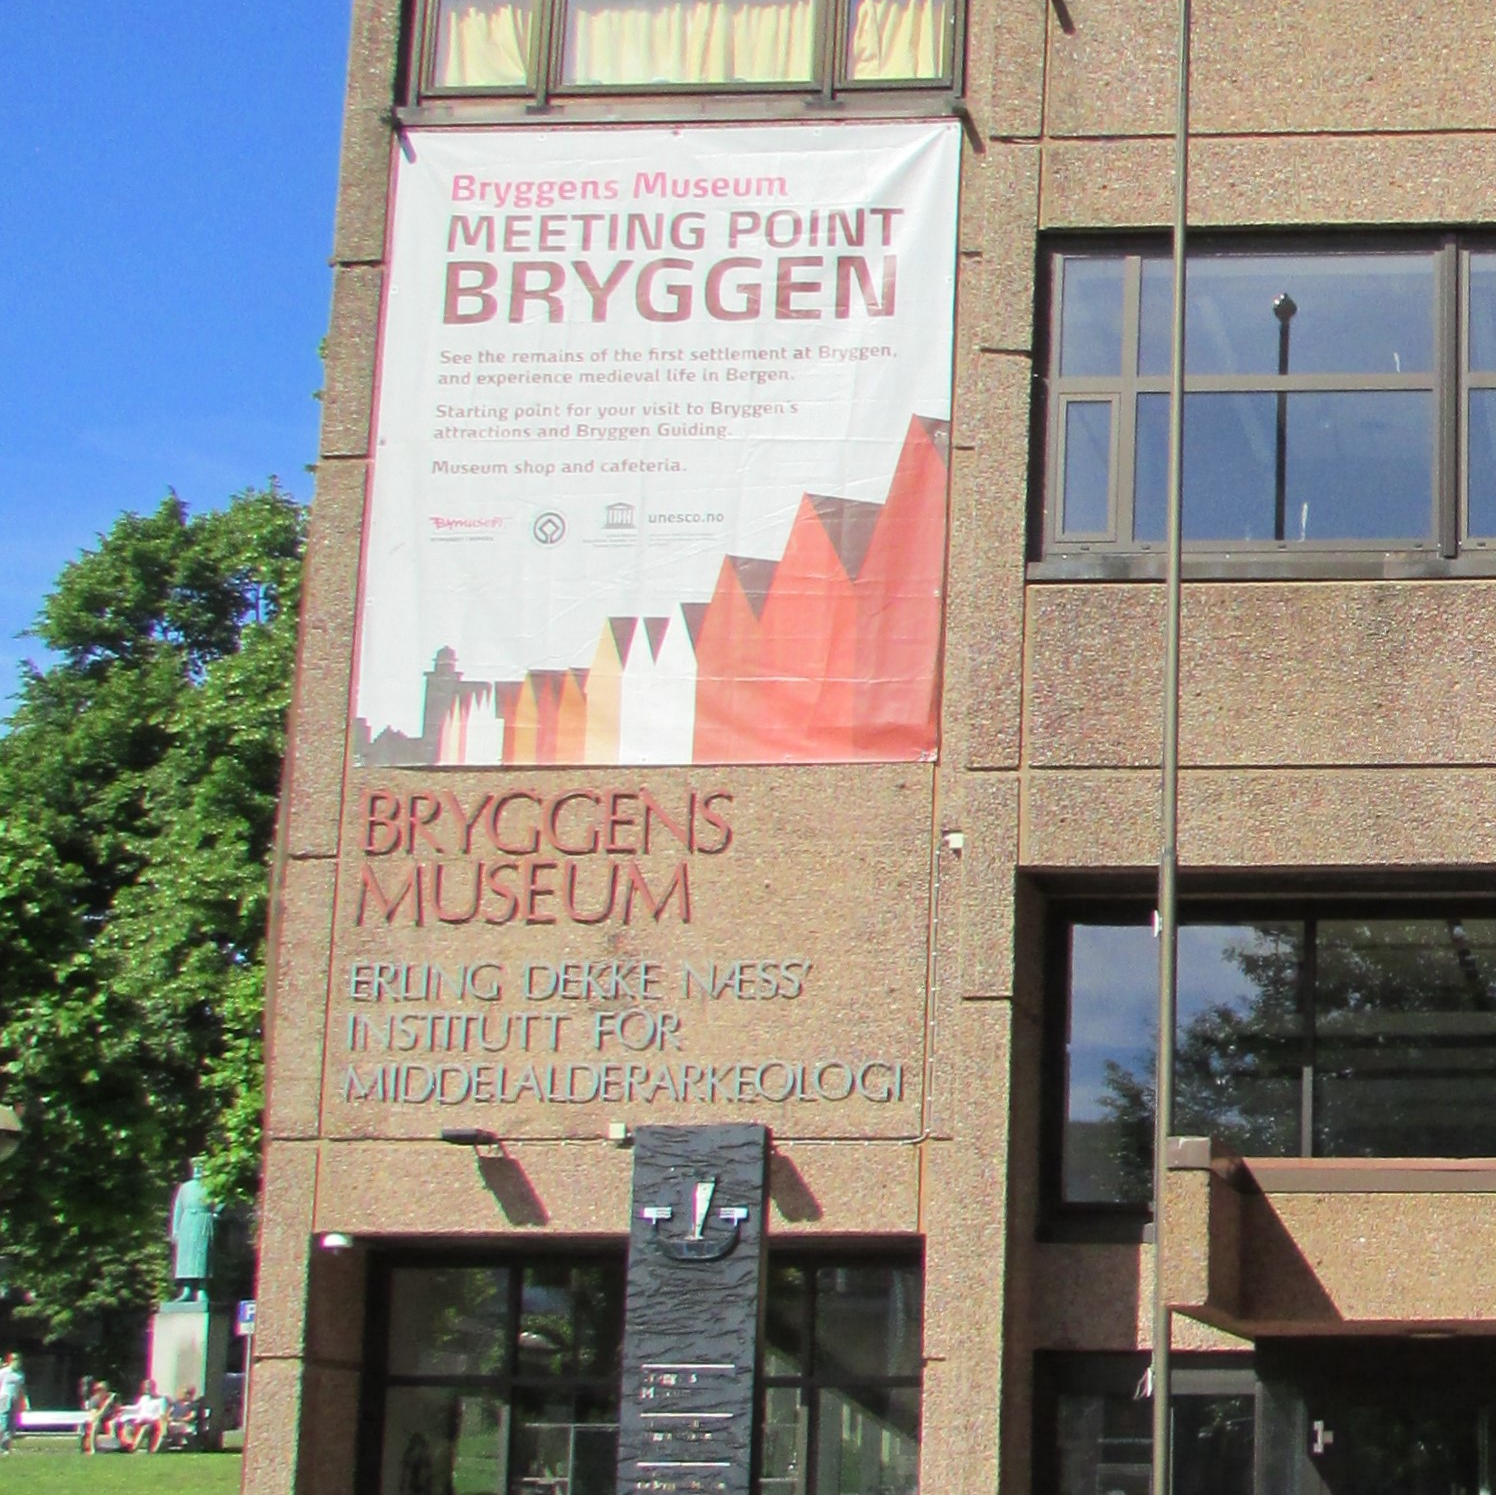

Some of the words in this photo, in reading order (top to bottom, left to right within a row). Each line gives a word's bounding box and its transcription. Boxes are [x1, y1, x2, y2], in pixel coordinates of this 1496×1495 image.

[451, 173, 620, 209] Bryggens
[632, 171, 789, 198] Museum
[446, 212, 707, 253] MEETING
[728, 208, 905, 249] POINT
[442, 255, 898, 325] BRYGGEN
[440, 350, 472, 365] See
[478, 350, 506, 364] the
[512, 349, 584, 364] remains
[590, 348, 609, 363] of
[614, 348, 643, 363] the
[648, 347, 684, 362] first
[690, 346, 788, 362] settlement
[793, 346, 812, 360] at
[818, 345, 898, 362] Bryggen,
[438, 371, 471, 385] and
[476, 370, 573, 387] experience
[579, 369, 660, 384] medieval
[666, 368, 697, 383] life
[702, 368, 720, 382] in
[725, 367, 795, 385] Bergen.
[433, 424, 531, 440] attractions
[537, 424, 571, 439] and
[576, 423, 651, 441] Bryggen
[657, 422, 733, 439] Guiding.
[435, 404, 509, 422] Starting
[514, 403, 561, 420] point
[566, 403, 592, 417] for
[597, 404, 636, 420] your
[642, 402, 680, 417] visit
[687, 402, 704, 416] to
[431, 460, 508, 475] Museum
[514, 459, 556, 477] shop
[561, 459, 595, 474] and
[600, 458, 687, 474] cafeteria.
[648, 512, 725, 524] unesco.no
[358, 788, 735, 856] BRYGGENS
[354, 860, 693, 928] MUSEUM
[349, 961, 500, 1003] ERLING
[522, 960, 663, 1001] DEKKE
[346, 1011, 573, 1053] INSTITUTT
[594, 1009, 684, 1052] FOR
[342, 1060, 904, 1105] MIDDELALDERARKEOLOGI
